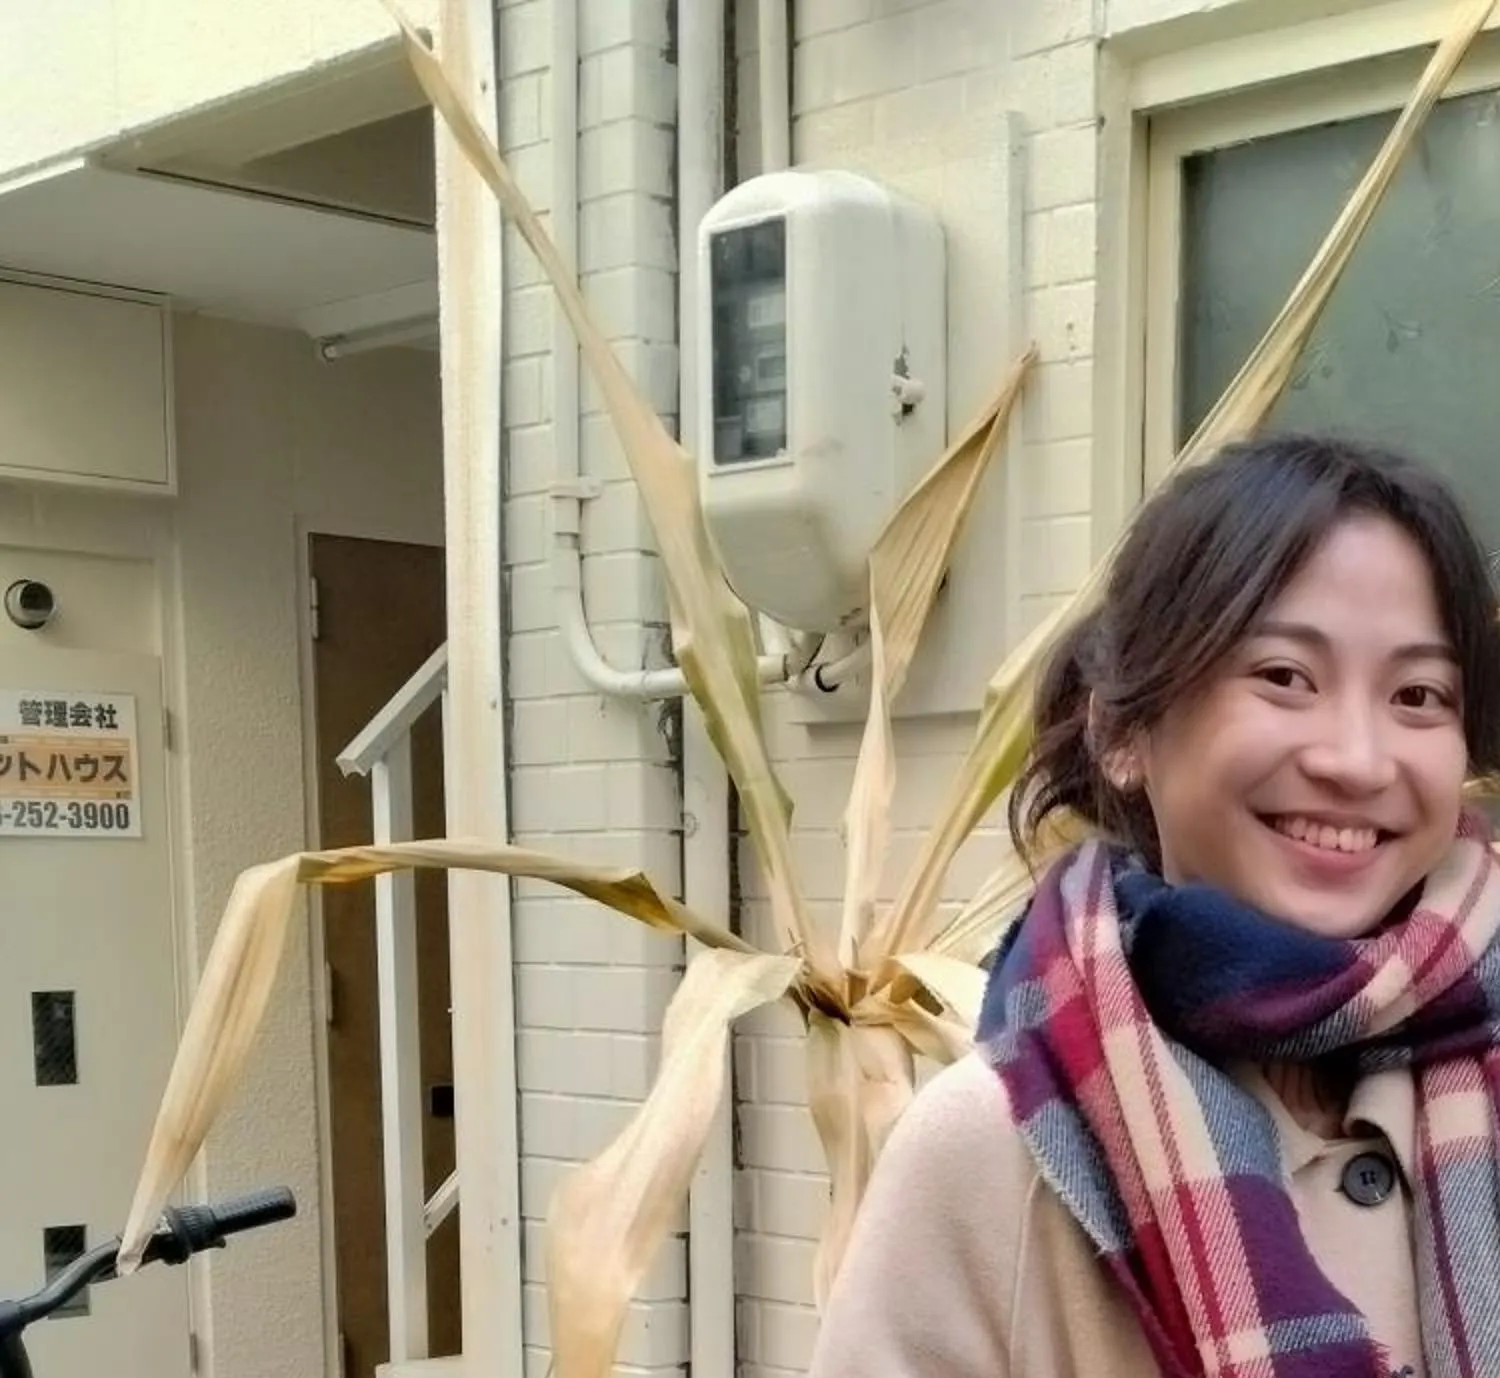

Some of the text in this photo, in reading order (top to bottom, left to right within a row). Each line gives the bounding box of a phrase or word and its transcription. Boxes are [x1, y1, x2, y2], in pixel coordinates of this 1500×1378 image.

[19, 699, 119, 729] 管理会社
[0, 801, 130, 829] -252-3900
